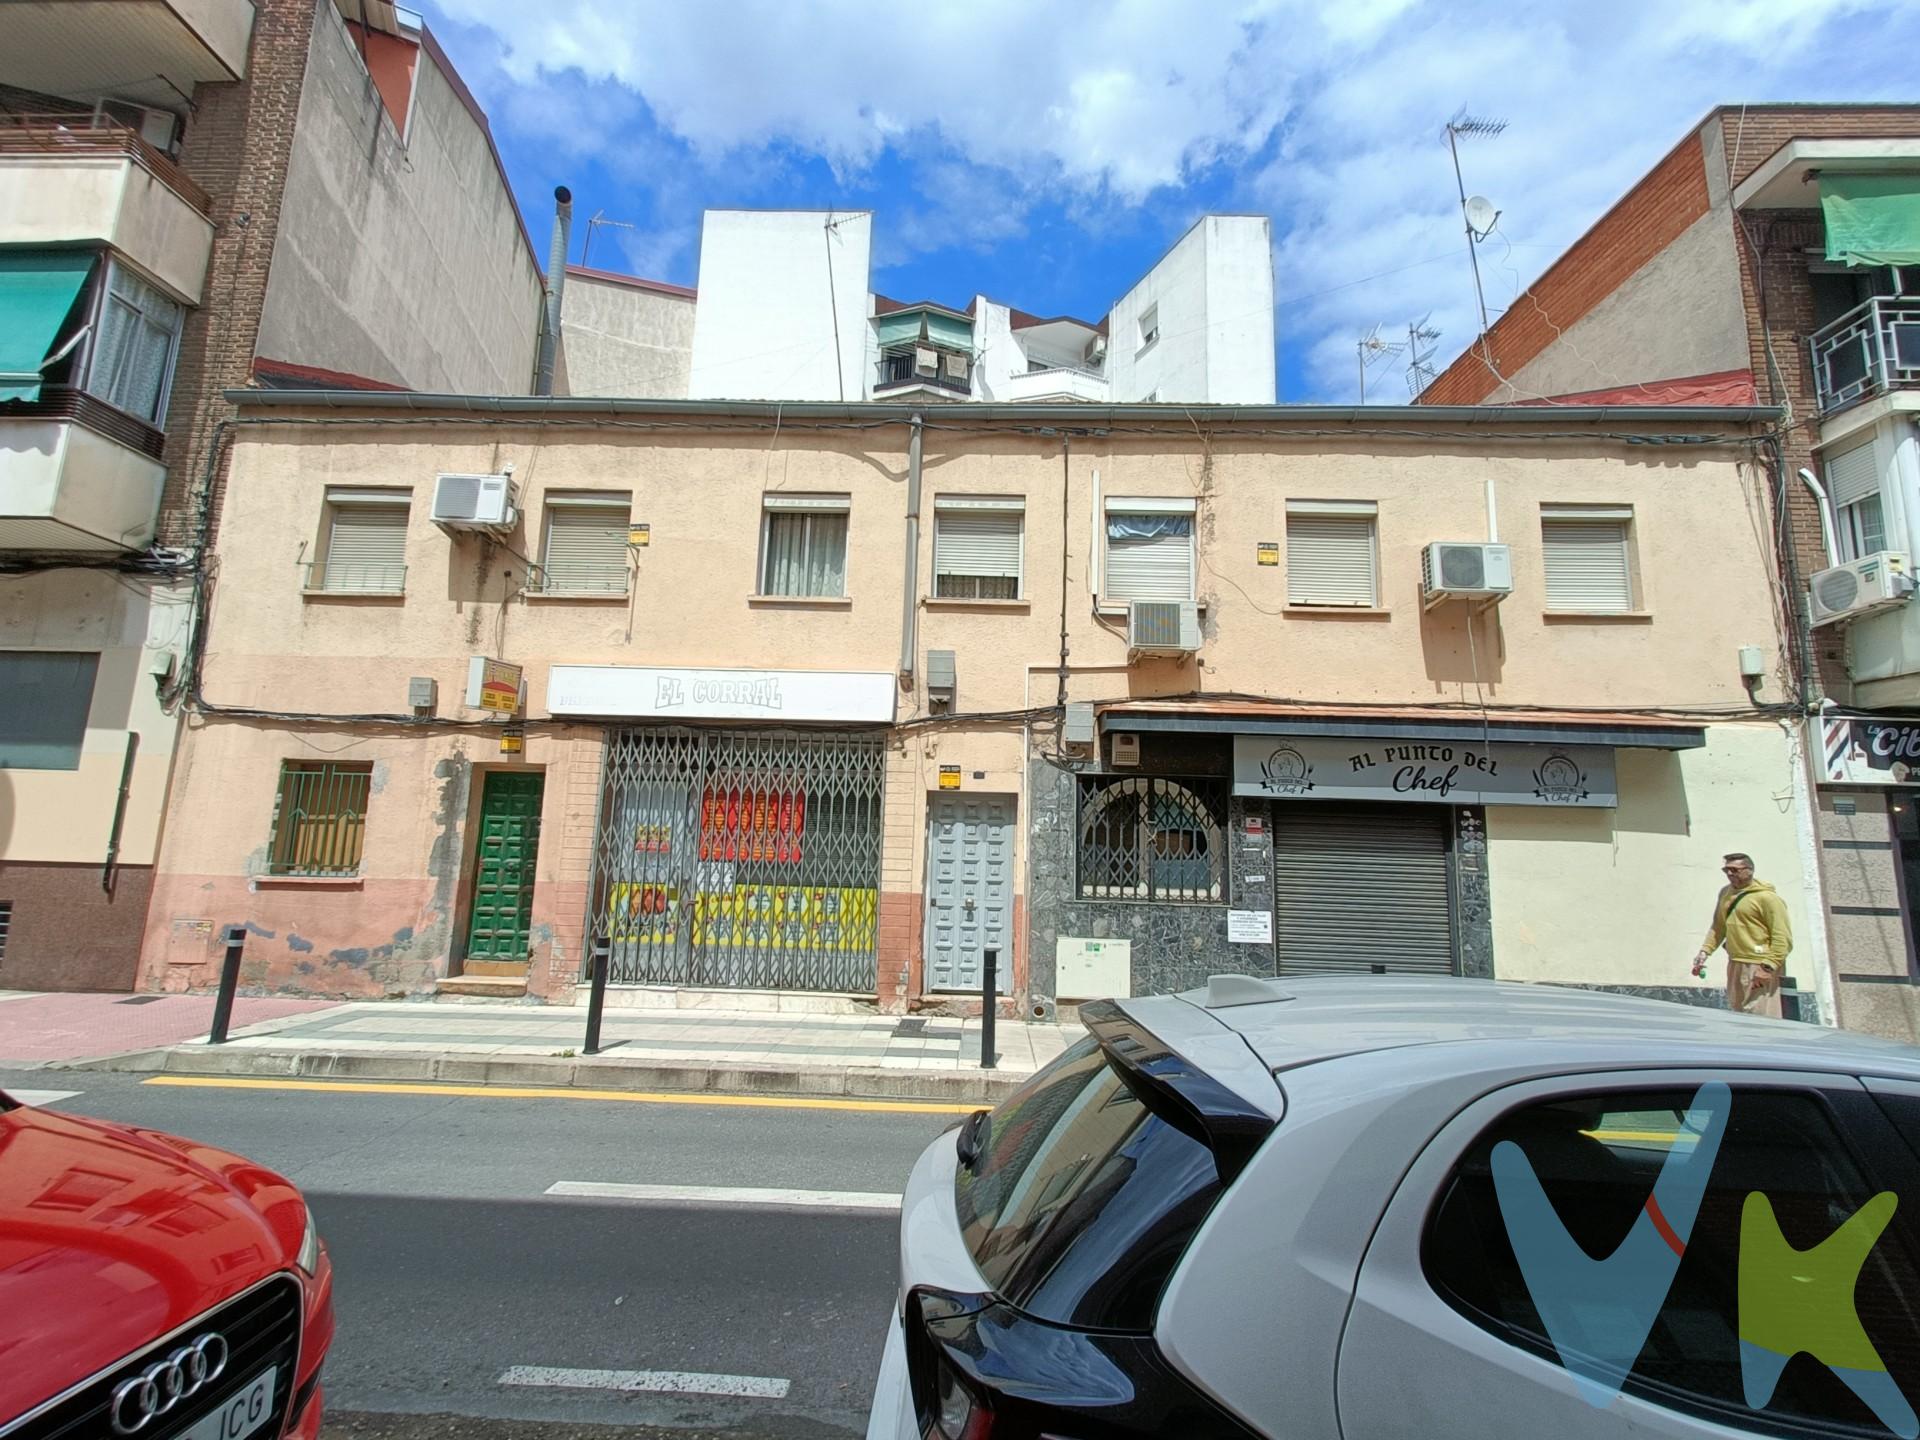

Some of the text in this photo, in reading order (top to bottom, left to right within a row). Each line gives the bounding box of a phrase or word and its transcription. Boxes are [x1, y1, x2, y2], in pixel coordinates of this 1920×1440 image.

[655, 676, 782, 710] EL CORRAL
[1349, 745, 1498, 777] AL PUNTO DEL
[1392, 764, 1459, 797] Chef
